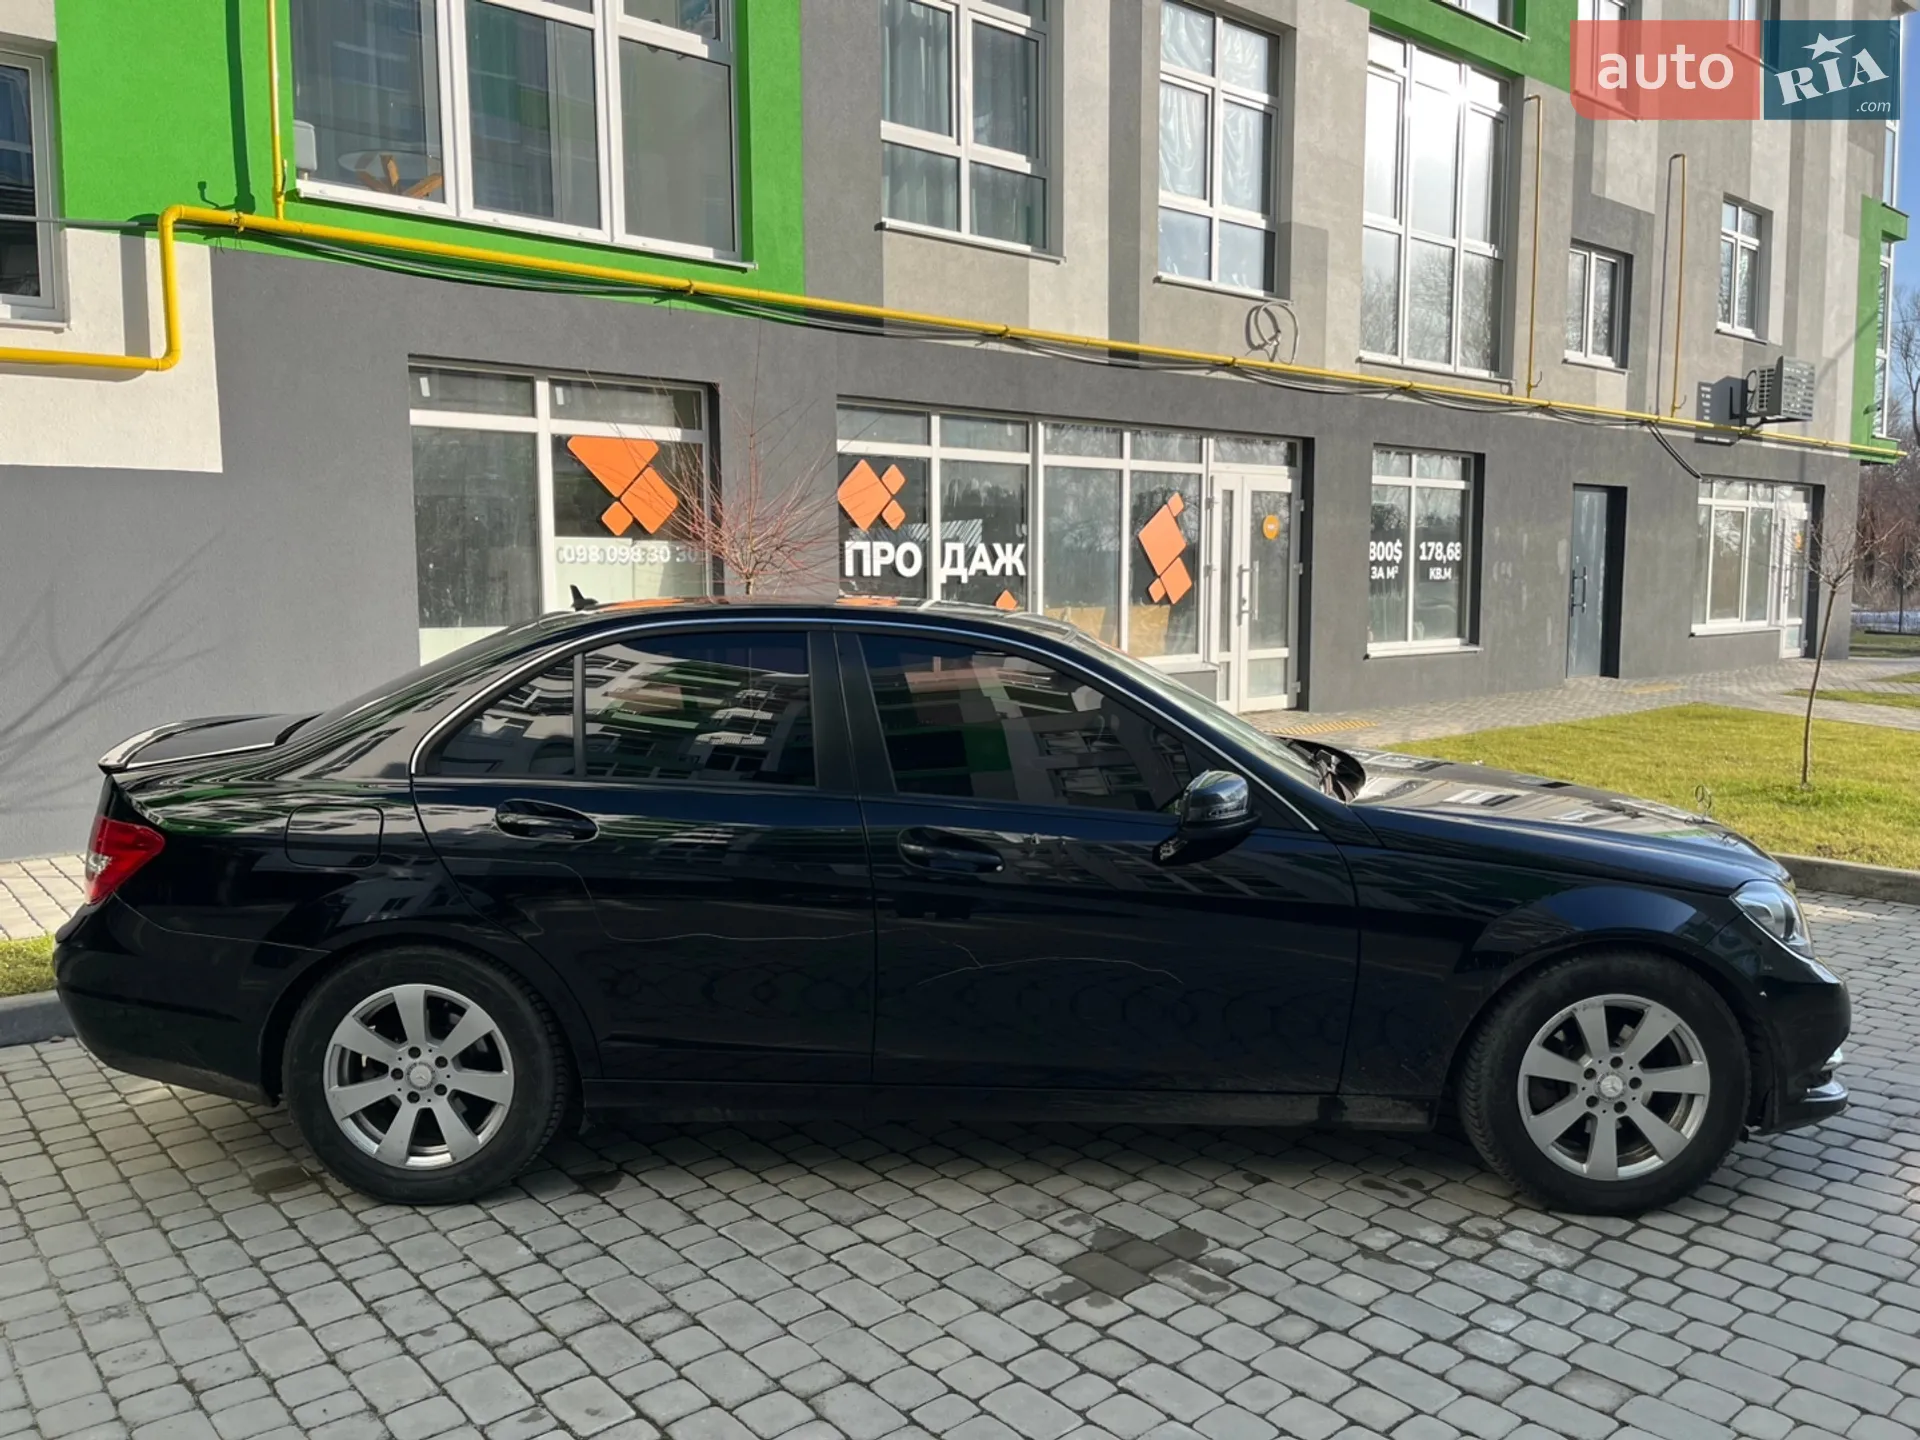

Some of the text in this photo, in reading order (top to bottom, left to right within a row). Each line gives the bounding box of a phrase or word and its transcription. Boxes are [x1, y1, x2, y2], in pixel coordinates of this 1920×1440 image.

[844, 541, 1026, 584] ПРО ДАЖ
[1419, 541, 1462, 564] 178,68
